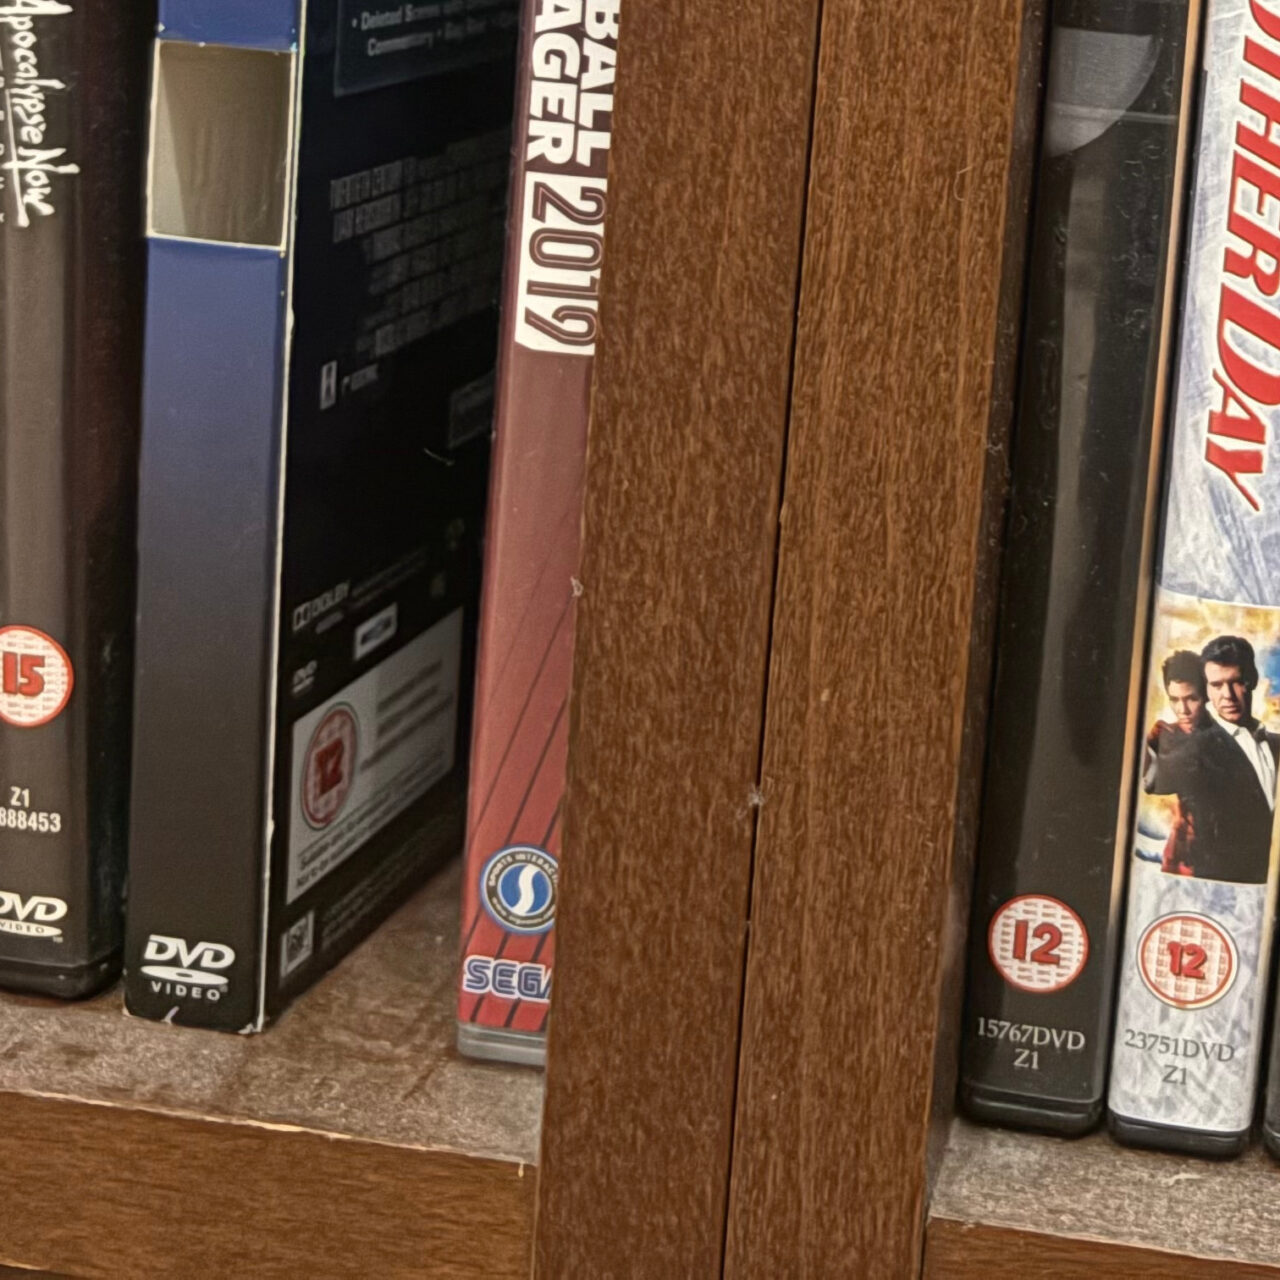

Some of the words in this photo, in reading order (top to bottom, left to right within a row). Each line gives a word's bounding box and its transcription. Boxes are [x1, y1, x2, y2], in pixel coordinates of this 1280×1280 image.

[2, 146, 80, 216] Now
[524, 180, 607, 347] 2019
[3, 651, 46, 698] 15
[10, 786, 30, 808] Z1
[144, 934, 236, 969] DVD
[1012, 919, 1063, 967] 12
[1166, 940, 1208, 980] 12
[151, 980, 220, 1001] VIDEO
[977, 1017, 1086, 1051] 15767DVD
[1124, 1029, 1235, 1062] 23751DVD
[1013, 1048, 1039, 1070] Z1
[1162, 1064, 1188, 1086] Z1
